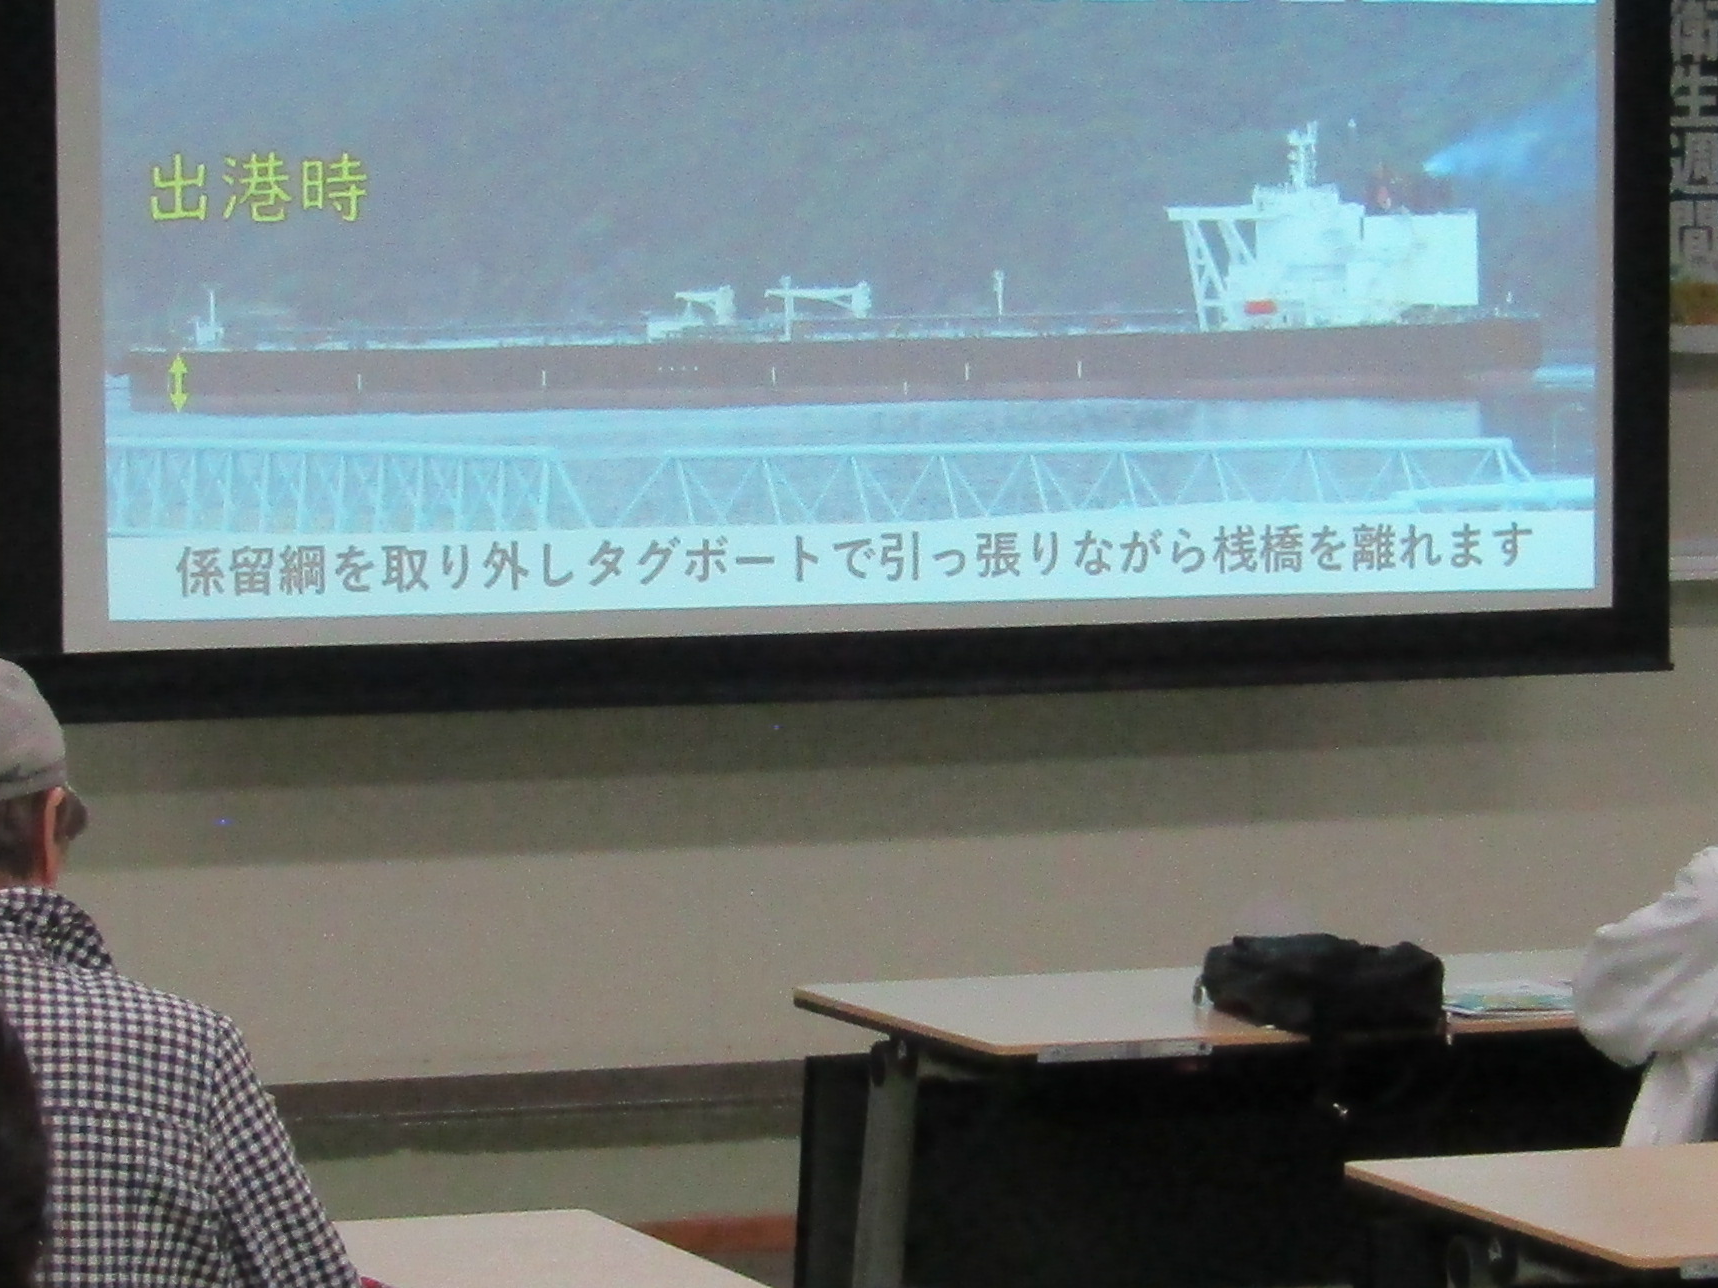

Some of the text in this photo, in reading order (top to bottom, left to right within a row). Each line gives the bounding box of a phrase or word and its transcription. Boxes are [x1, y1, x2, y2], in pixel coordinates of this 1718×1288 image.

[149, 151, 369, 223] 出港時
[176, 520, 1535, 596] 係留綱を取り外しタグボートで引っ張りながら桟橋を離れます
